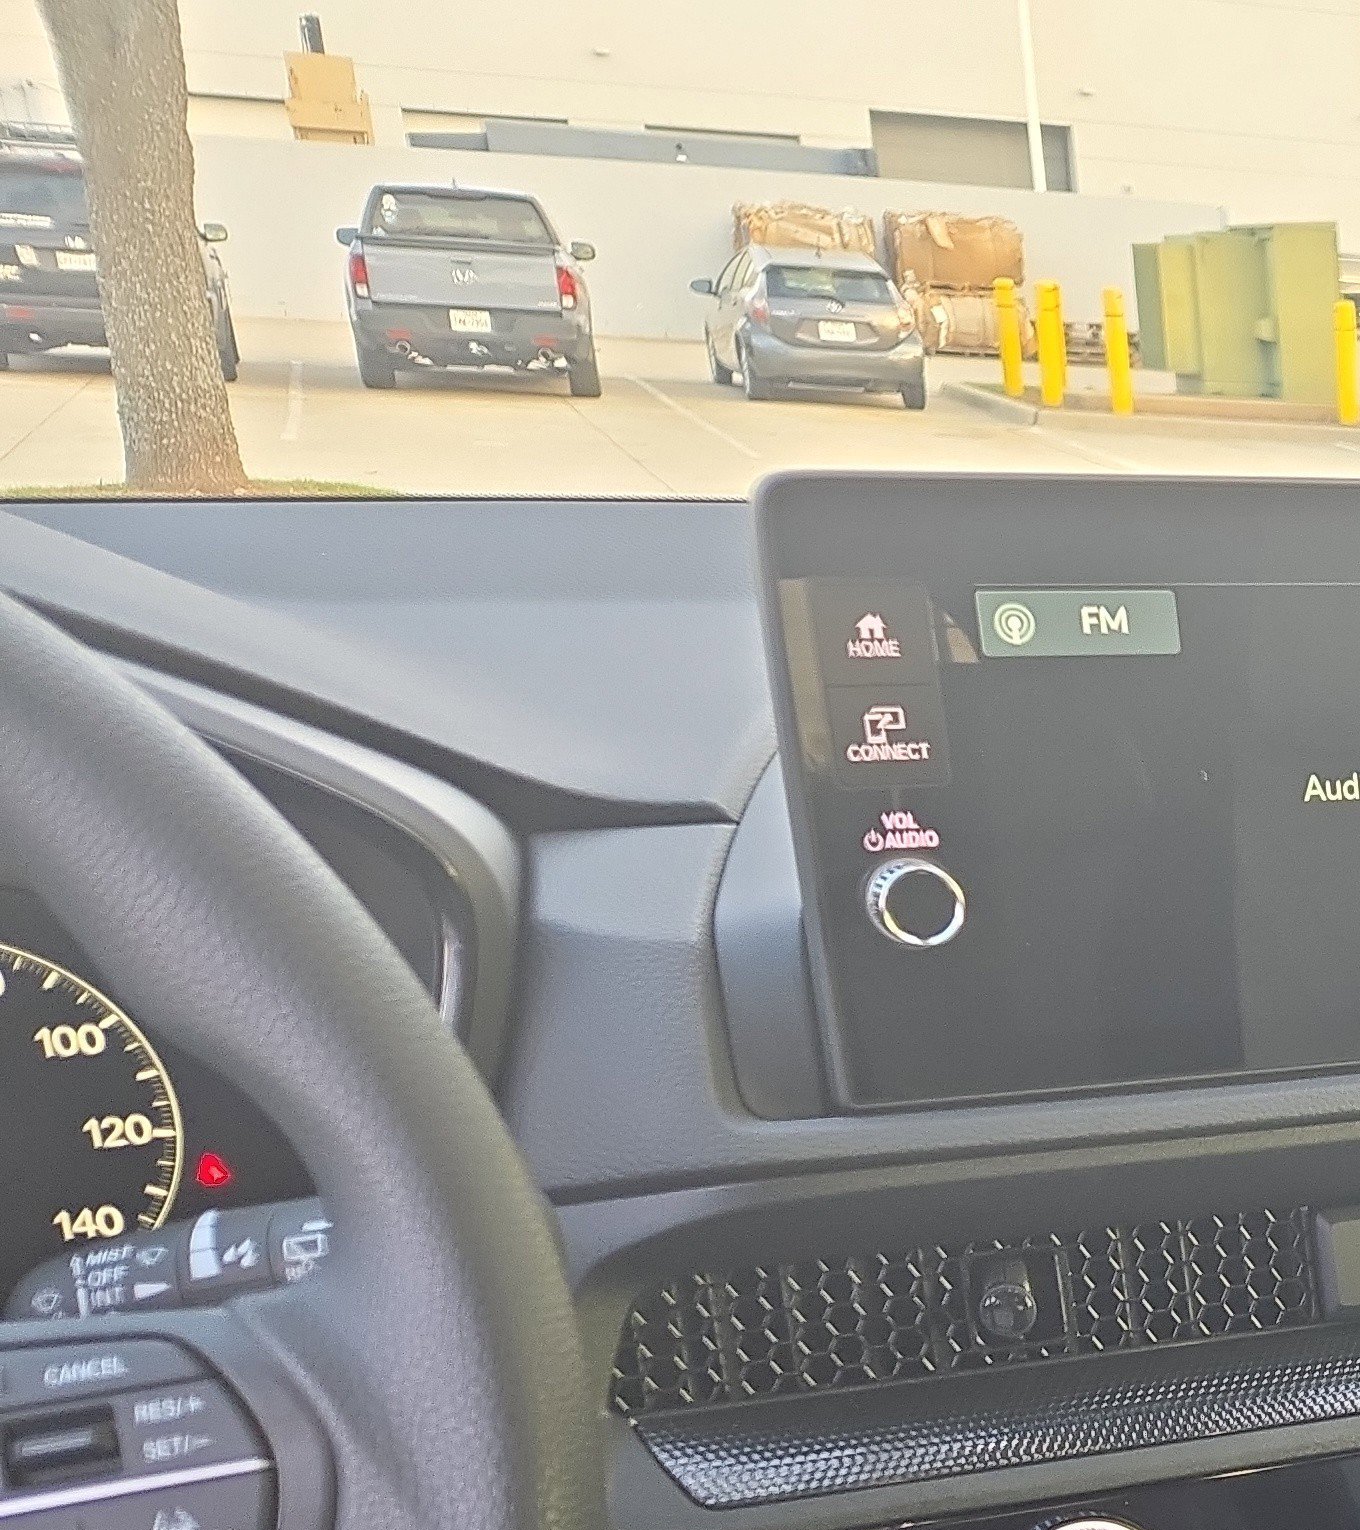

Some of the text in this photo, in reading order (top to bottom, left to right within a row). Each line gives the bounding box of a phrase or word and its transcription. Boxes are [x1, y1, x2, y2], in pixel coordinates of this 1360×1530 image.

[1081, 604, 1130, 635] FM
[847, 639, 901, 658] HOME
[847, 742, 931, 761] CONNECT
[881, 811, 919, 829] VOL
[885, 830, 940, 849] AUDIO
[34, 1023, 106, 1059] 100
[82, 1113, 152, 1150] 120
[53, 1205, 124, 1242] 140
[44, 1356, 127, 1387] CANCEL
